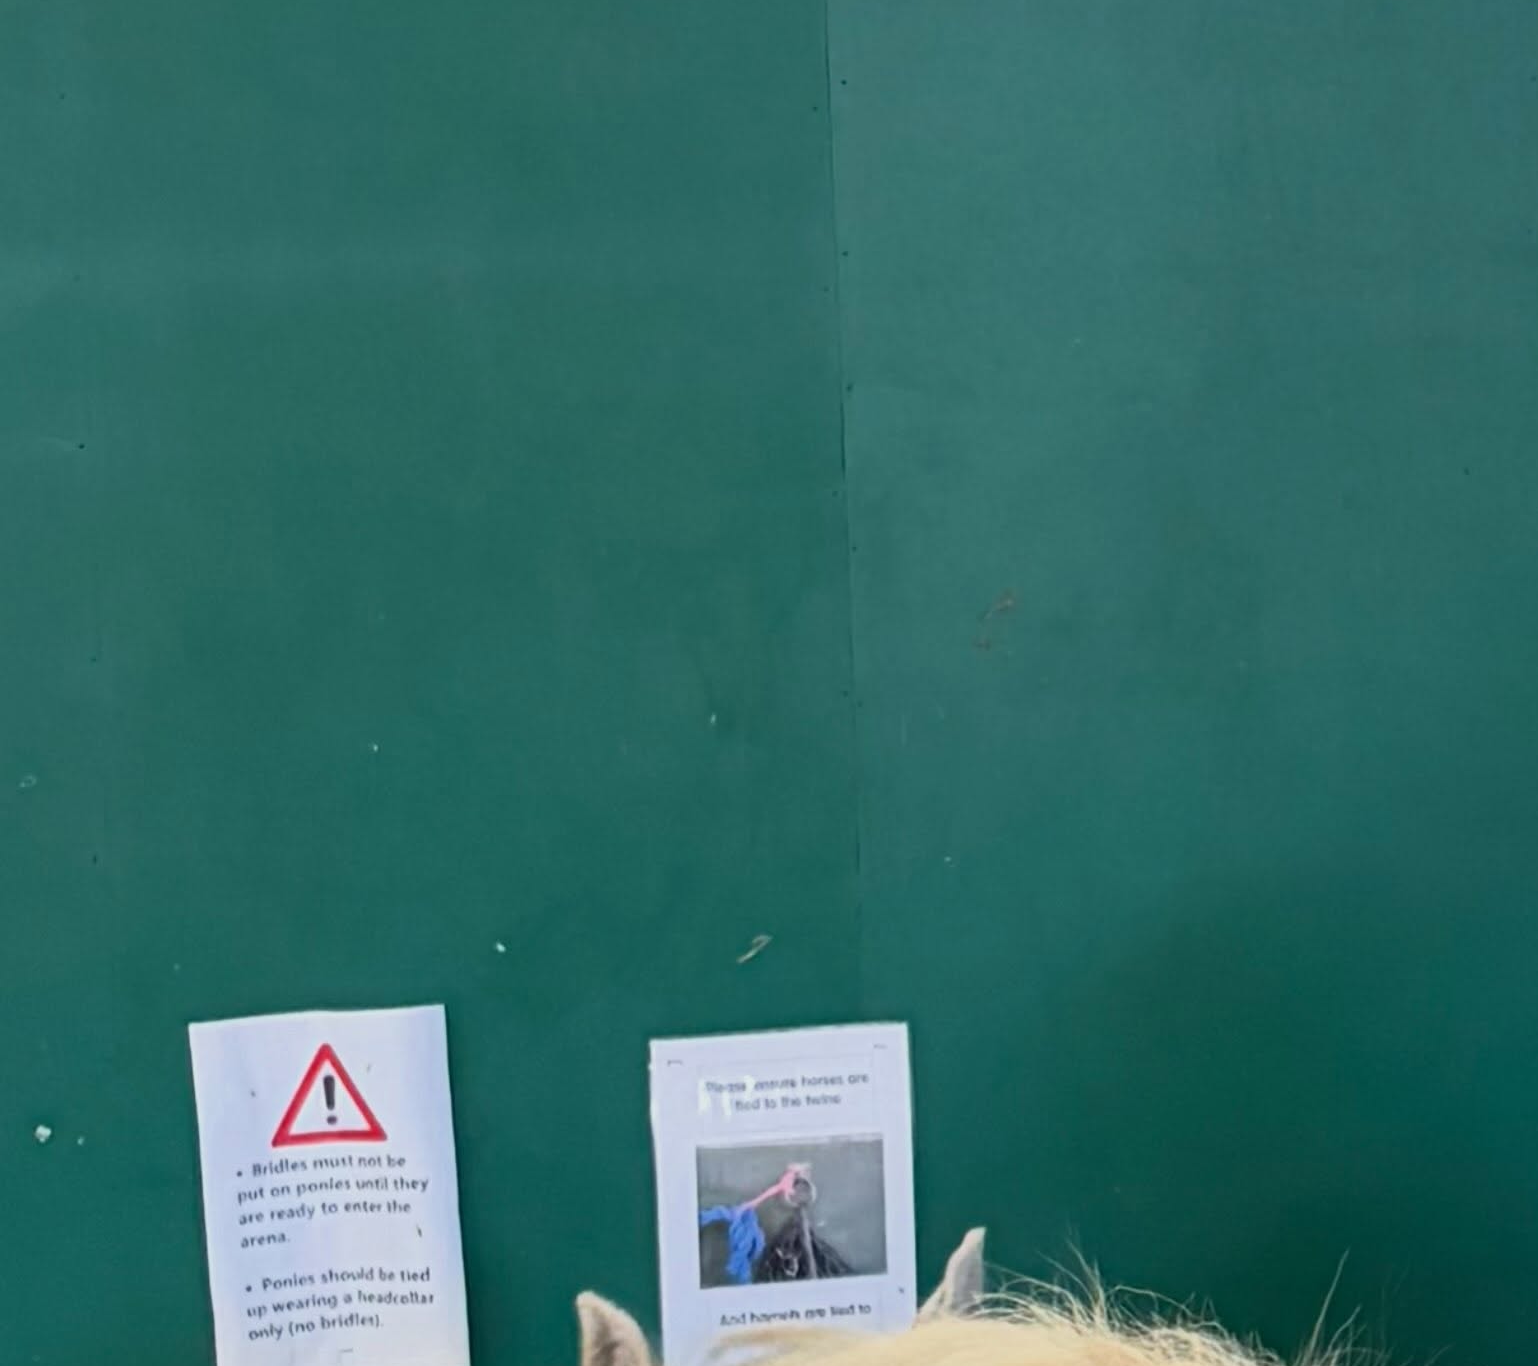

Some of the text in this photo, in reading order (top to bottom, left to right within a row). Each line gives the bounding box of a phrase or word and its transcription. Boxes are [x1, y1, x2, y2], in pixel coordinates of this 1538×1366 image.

[801, 1075, 844, 1086] horses
[848, 1073, 869, 1084] are
[764, 1098, 777, 1109] to
[252, 1154, 406, 1177] Bridles must not be
[237, 1176, 429, 1206] put on ponies until they
[239, 1199, 412, 1226] are ready to enter the
[240, 1232, 291, 1249] arena.
[261, 1266, 431, 1292] Ponies should be tied
[247, 1290, 434, 1319] up wearing a headcollar
[858, 1304, 872, 1315] to
[248, 1324, 283, 1341] only
[288, 1321, 316, 1337] (no
